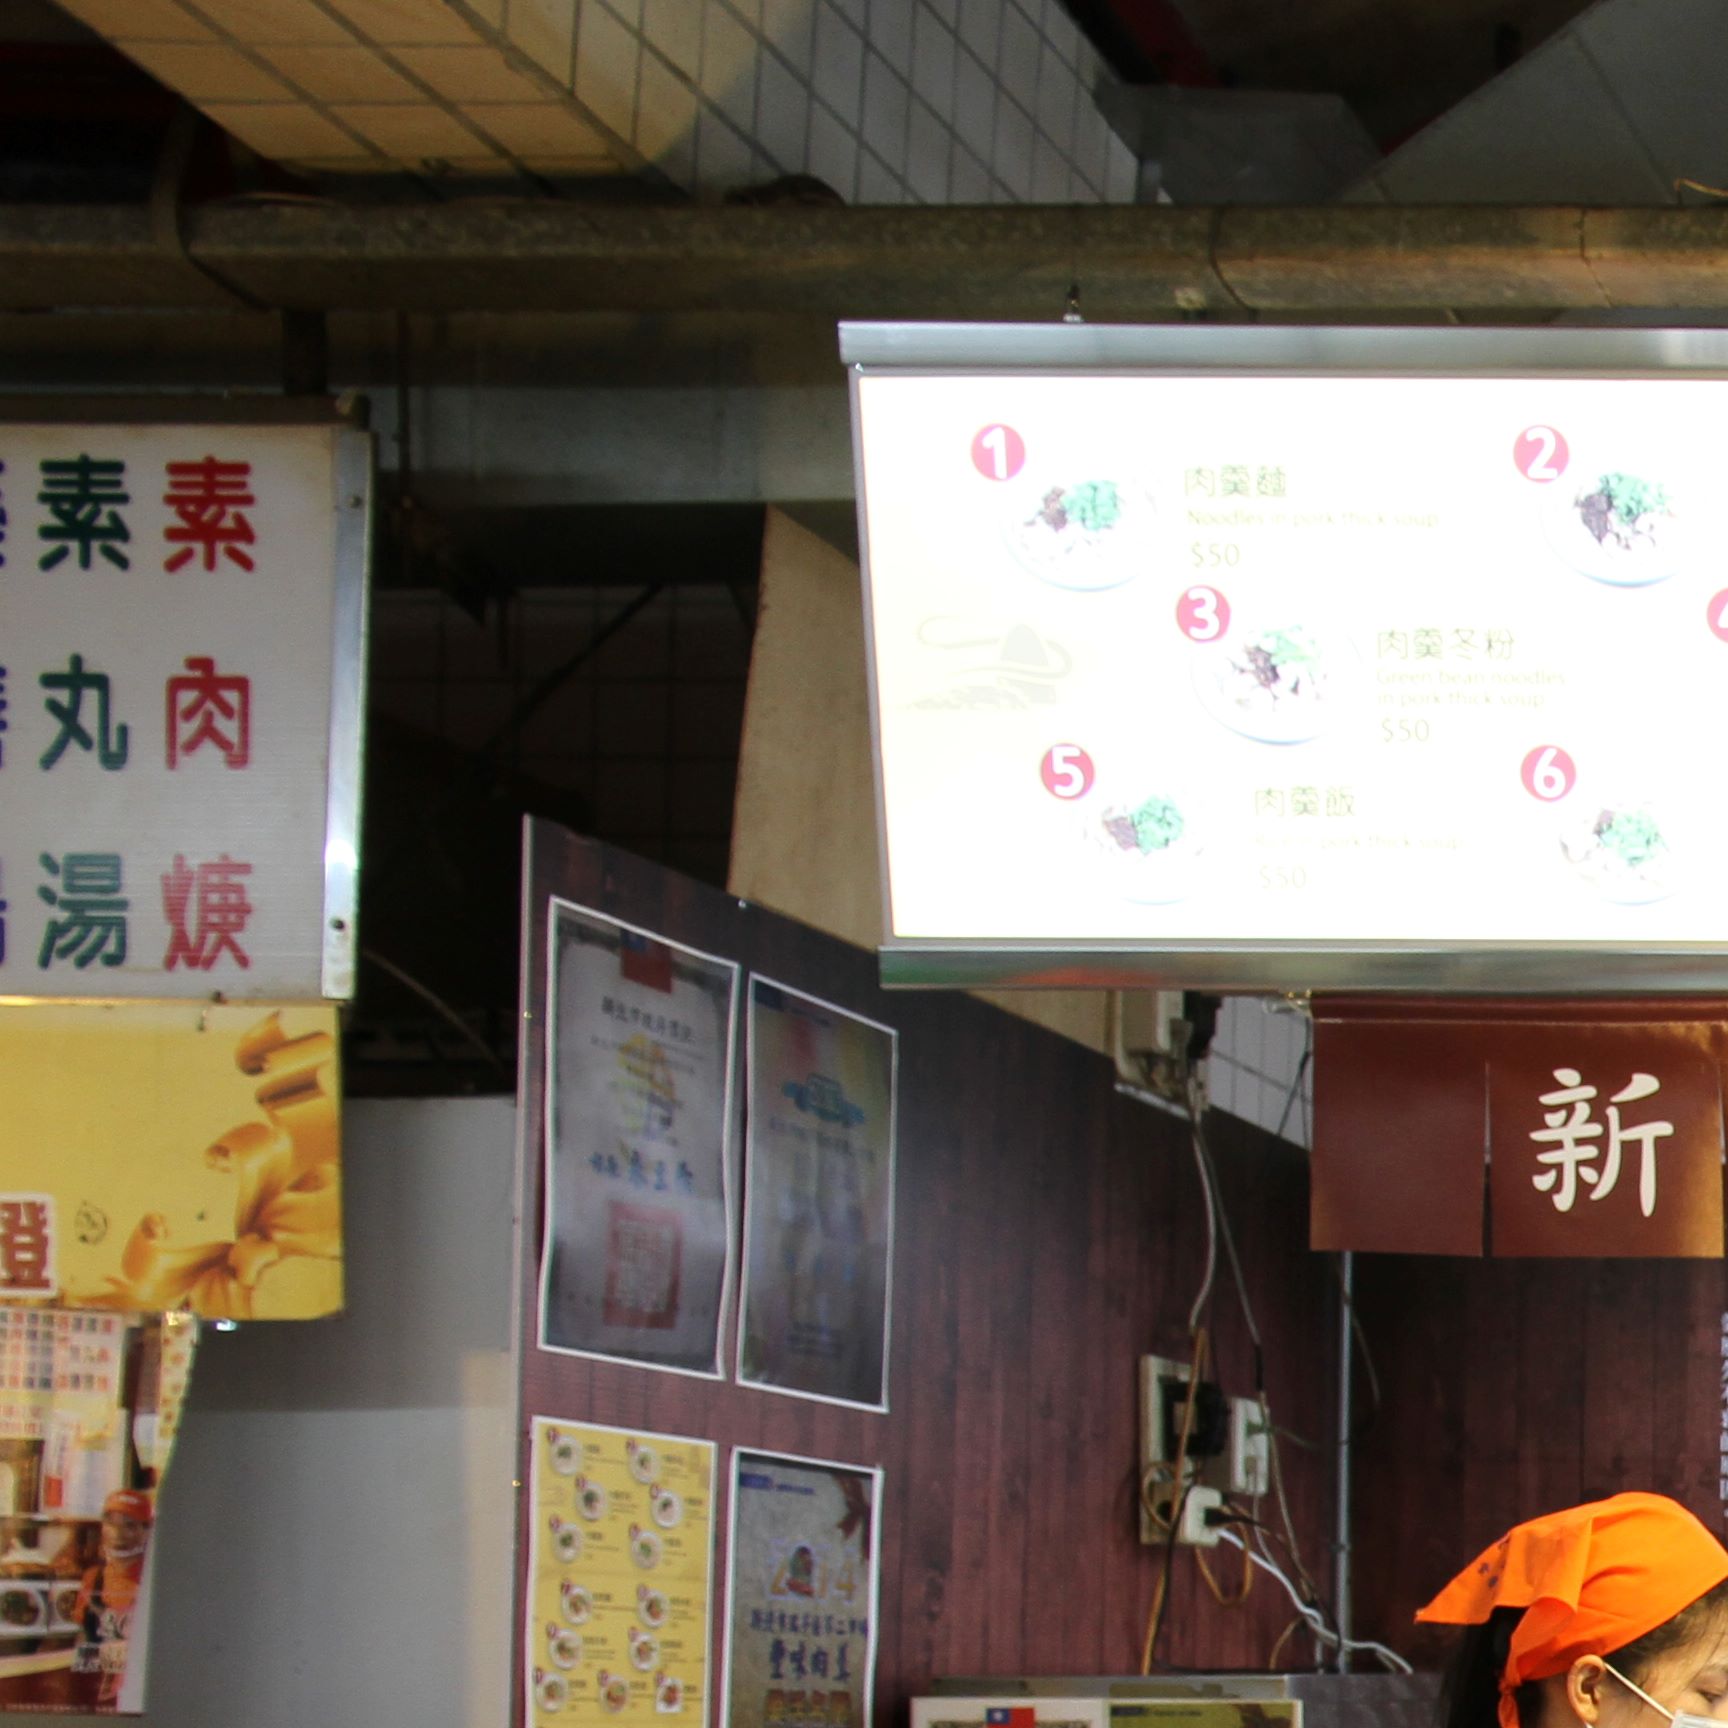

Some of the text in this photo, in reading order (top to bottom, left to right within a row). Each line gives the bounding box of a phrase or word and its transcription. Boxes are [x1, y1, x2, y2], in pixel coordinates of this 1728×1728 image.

[983, 427, 1007, 479] 1
[1528, 427, 1557, 477] 2
[1190, 541, 1241, 568] $50
[1189, 588, 1217, 638] 3
[1377, 626, 1515, 660] 肉羹冬粉
[37, 453, 131, 971] 素丸湯
[1380, 718, 1430, 744] $50
[1053, 747, 1084, 799] 5
[1534, 748, 1566, 800] 6
